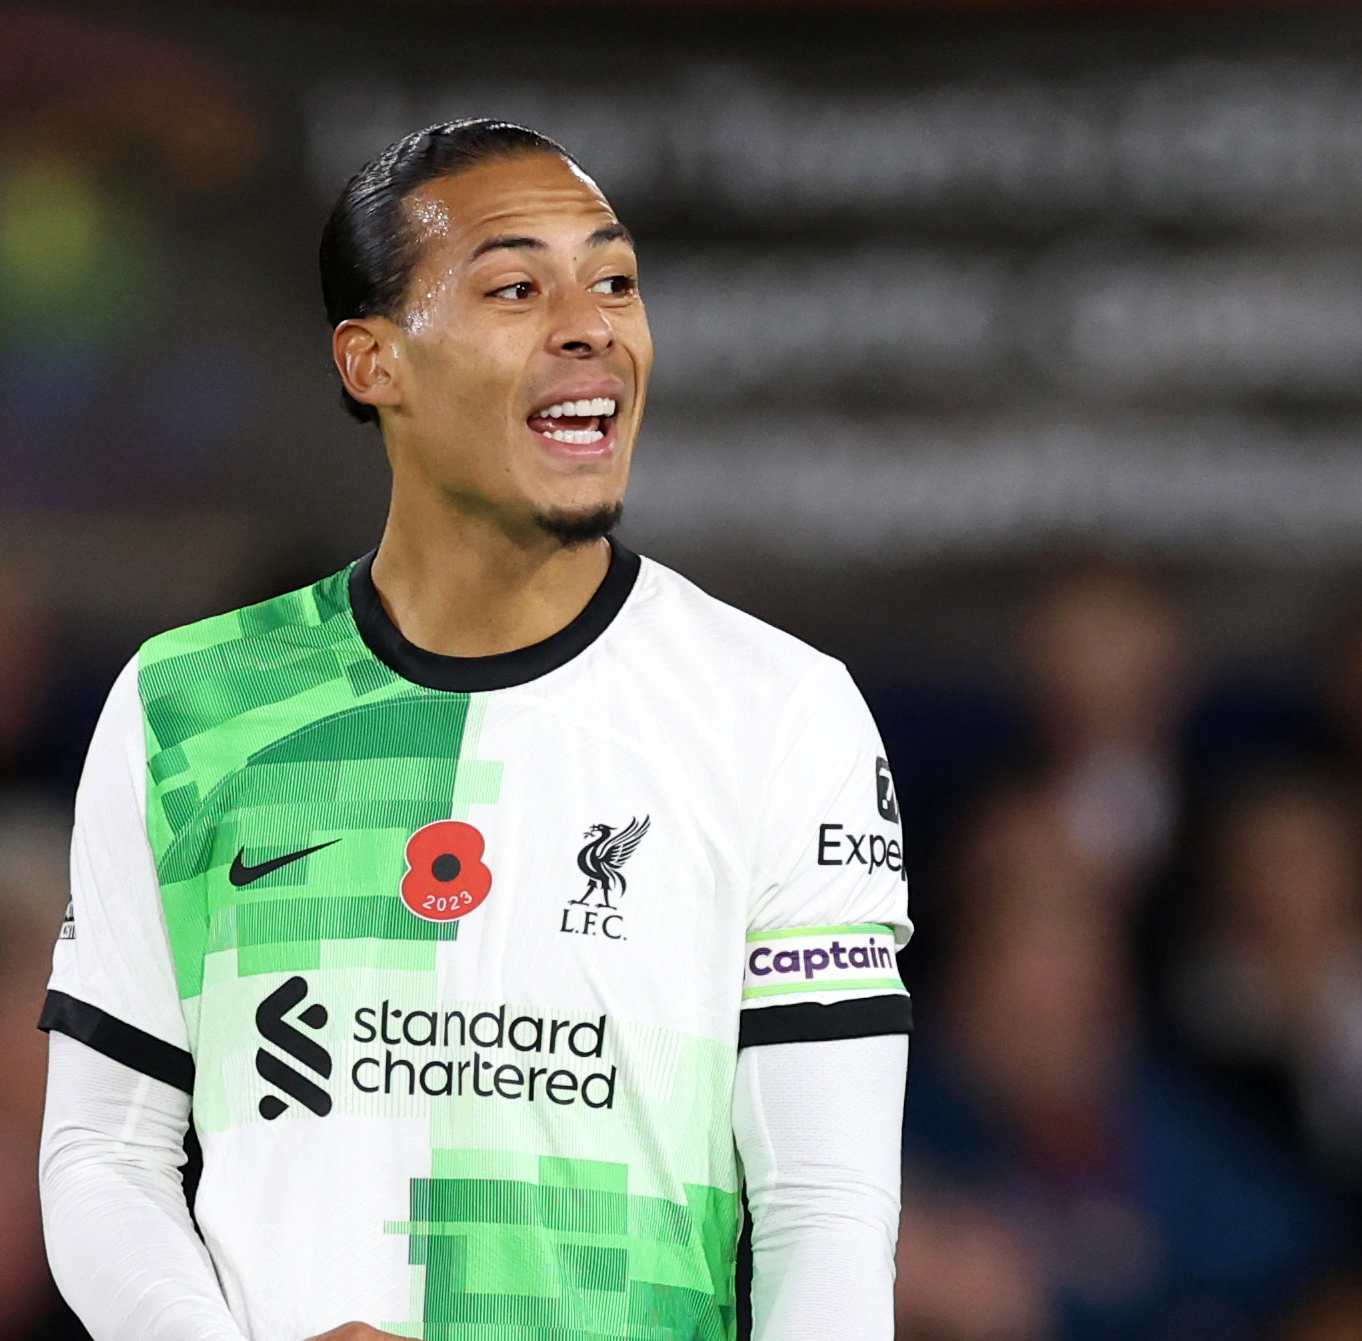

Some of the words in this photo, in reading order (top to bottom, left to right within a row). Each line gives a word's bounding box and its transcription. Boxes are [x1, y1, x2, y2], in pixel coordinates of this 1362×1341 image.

[423, 891, 472, 911] 2023
[560, 909, 627, 941] L.F.C.
[353, 999, 607, 1058] standard
[351, 1049, 617, 1109] chartered
